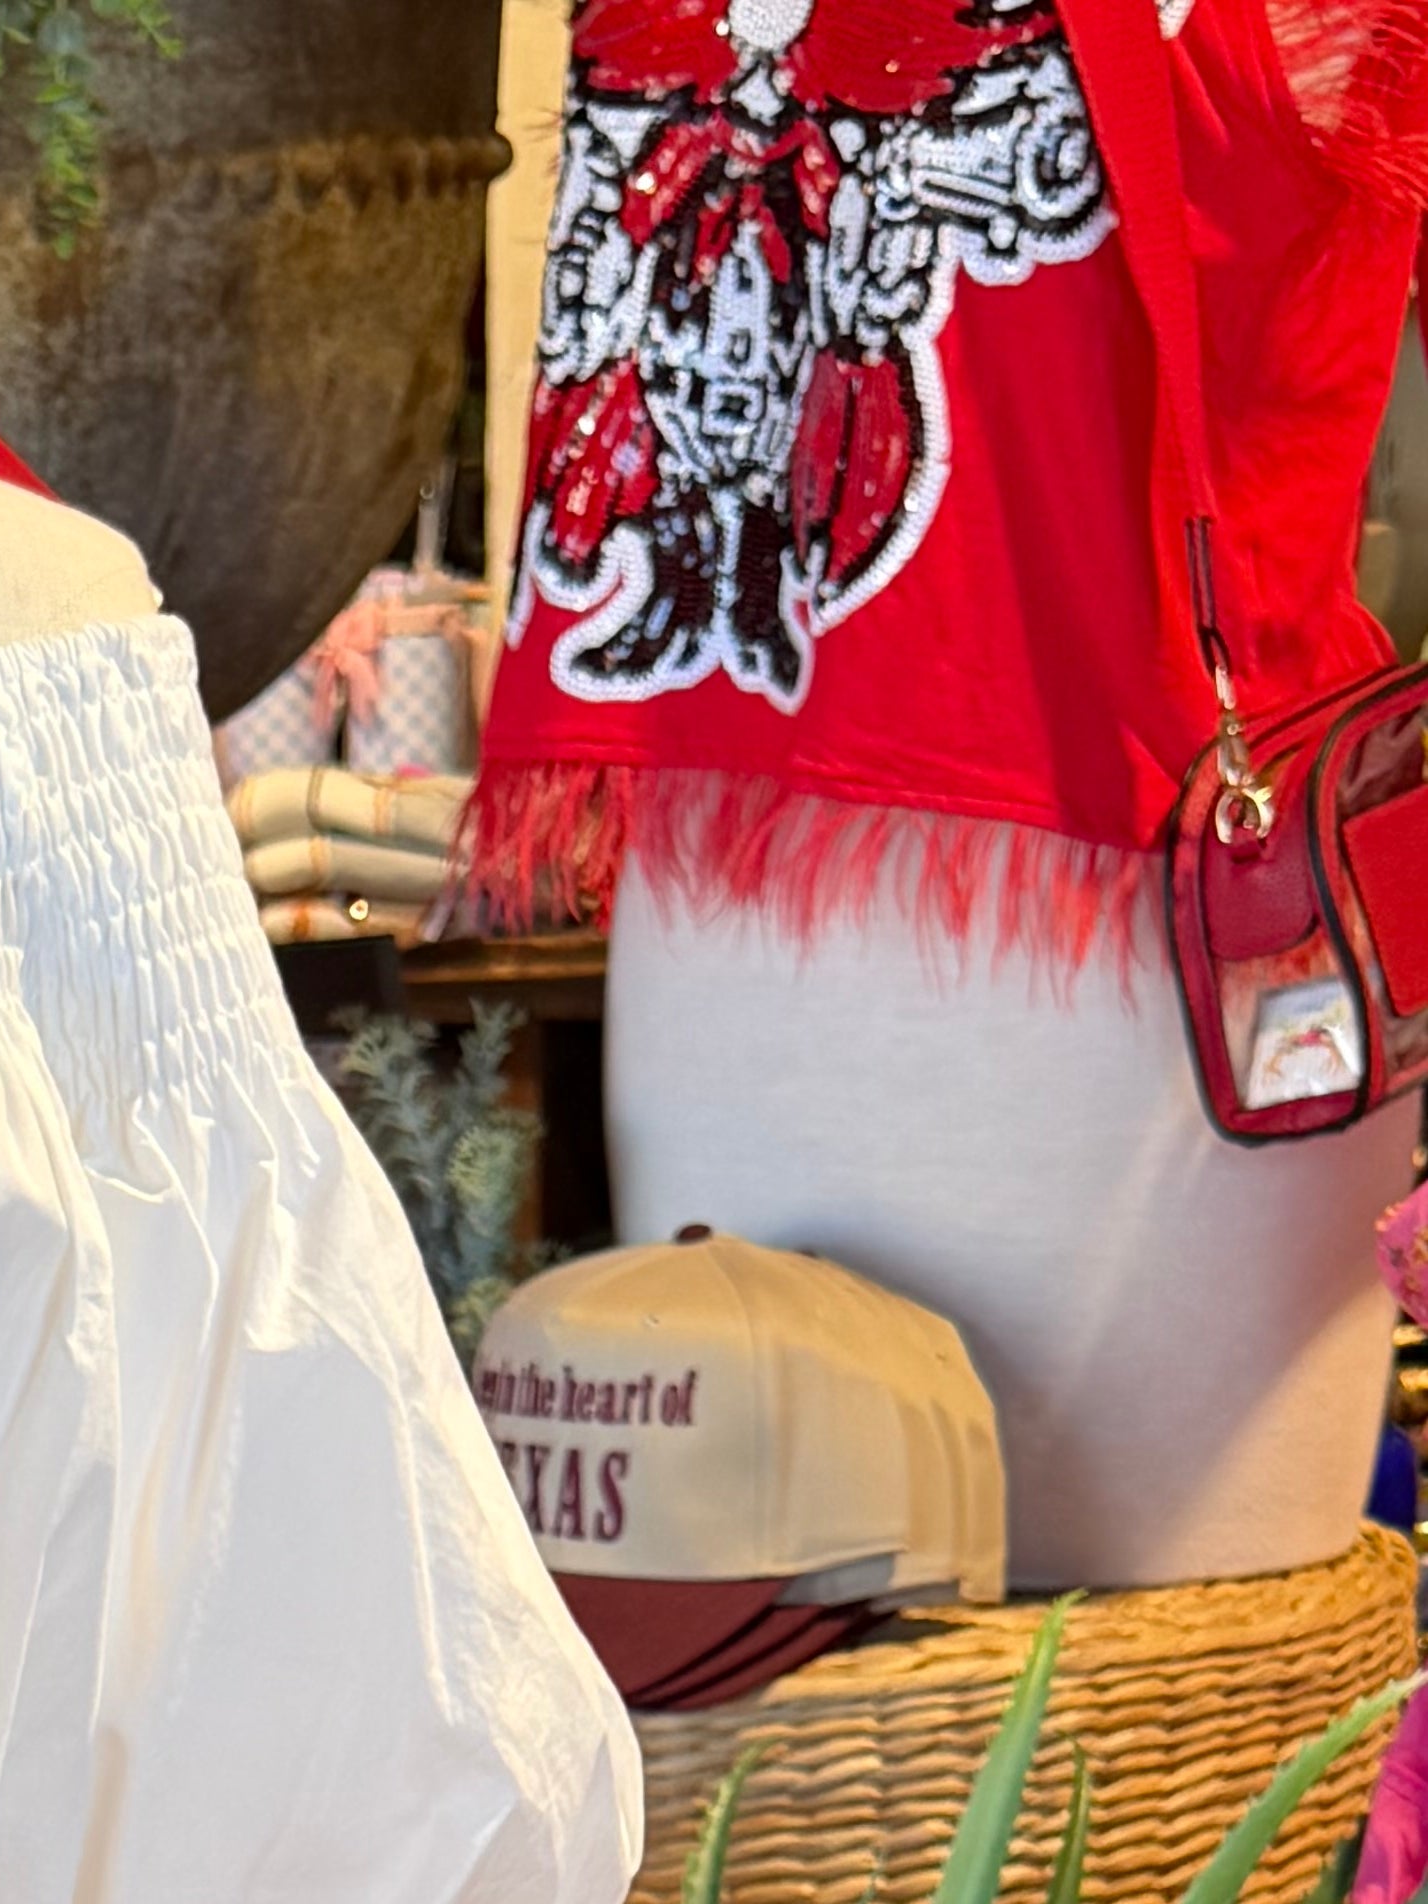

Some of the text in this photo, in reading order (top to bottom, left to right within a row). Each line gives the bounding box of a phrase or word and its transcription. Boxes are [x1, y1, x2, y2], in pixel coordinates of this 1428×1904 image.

[517, 1361, 555, 1418] the
[560, 1366, 654, 1425] heart
[661, 1369, 698, 1427] of
[494, 1438, 629, 1542] XAS
